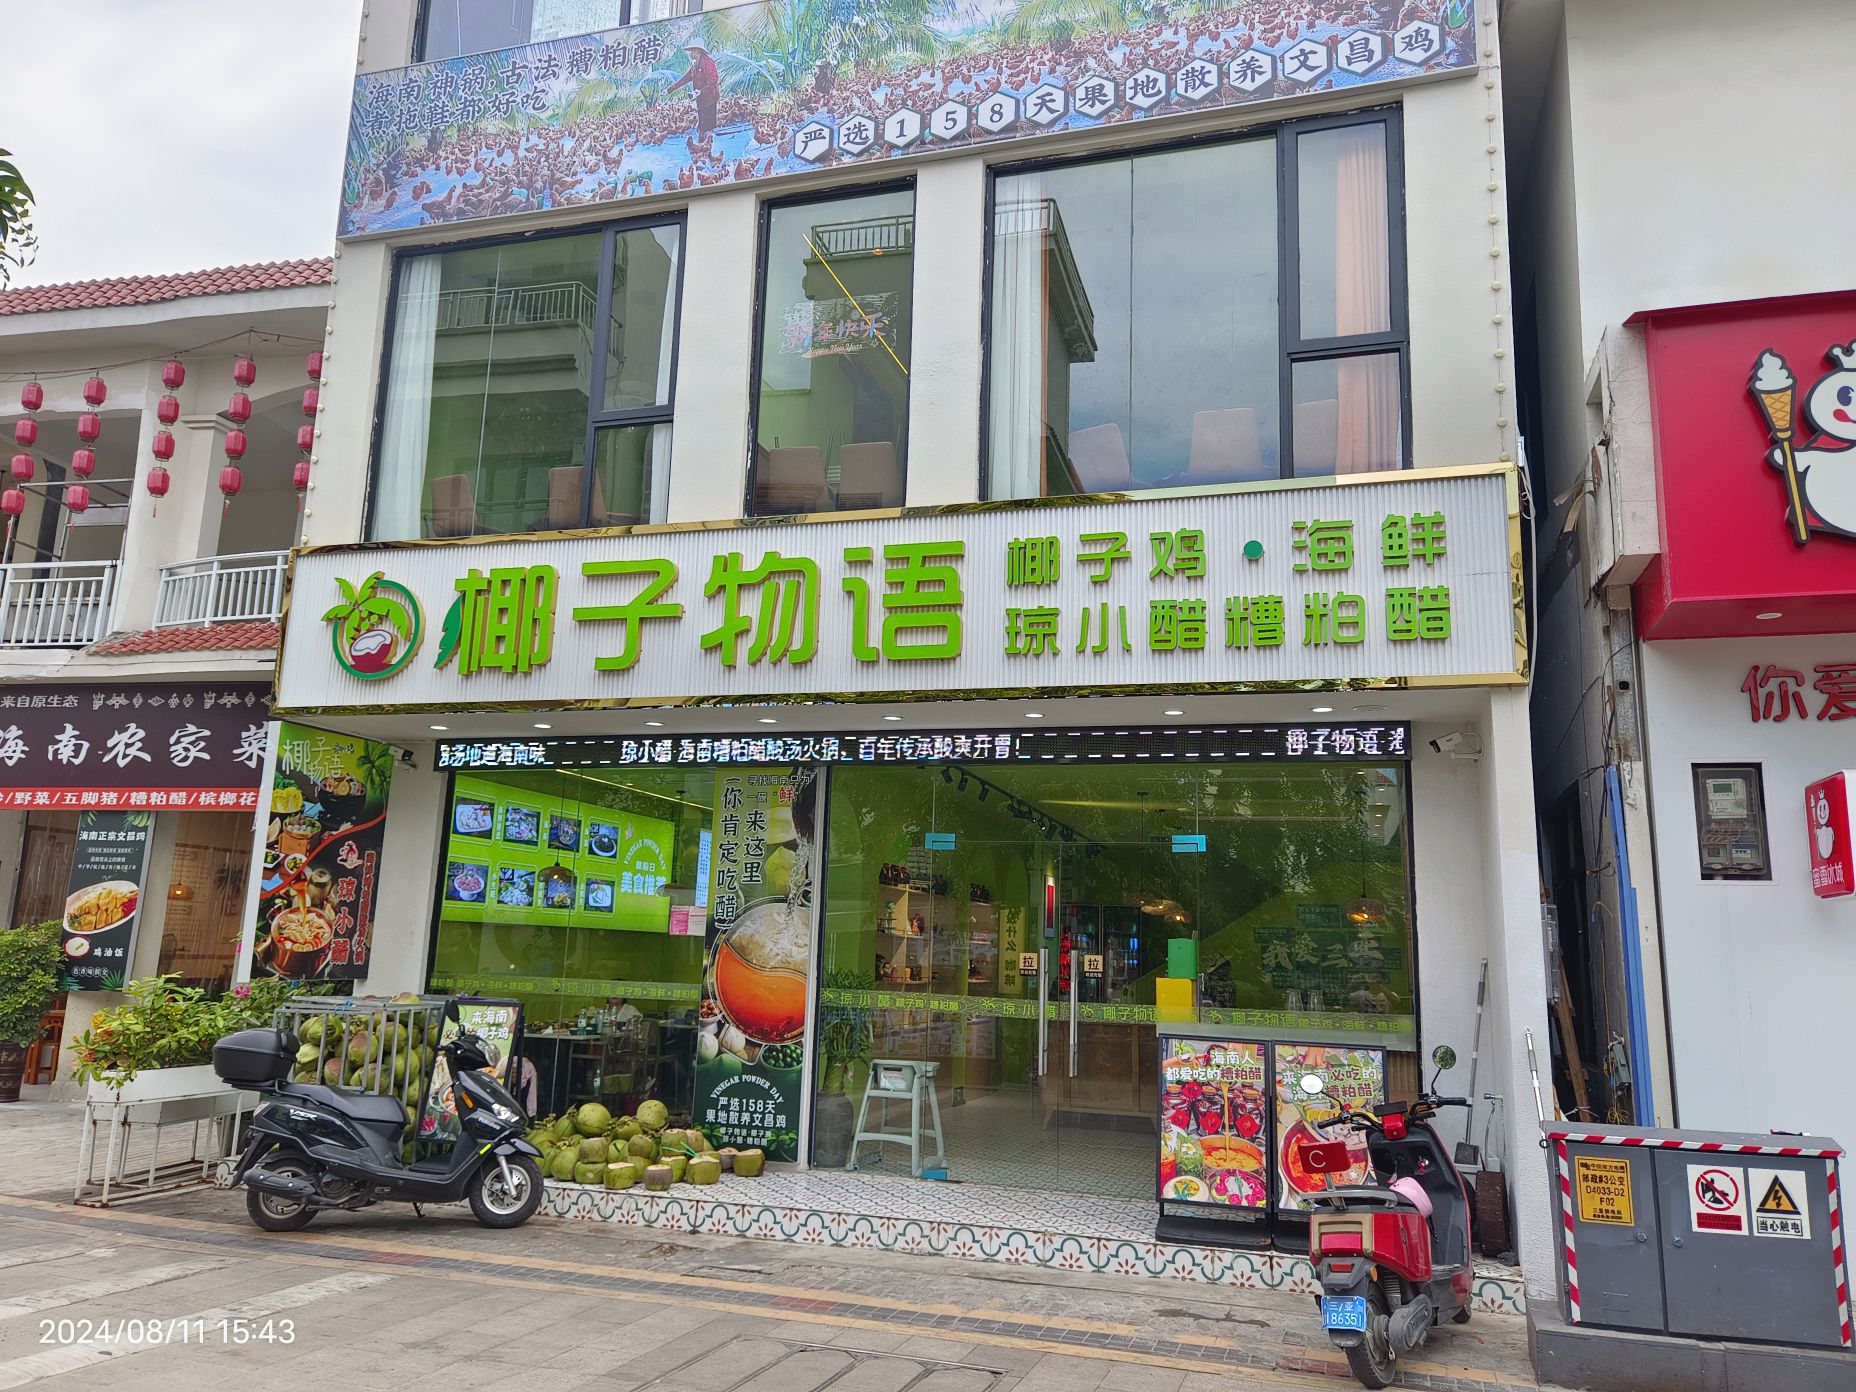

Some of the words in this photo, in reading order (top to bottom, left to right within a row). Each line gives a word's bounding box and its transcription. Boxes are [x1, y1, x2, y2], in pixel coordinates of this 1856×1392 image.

[799, 26, 1436, 154] 严选158天果地散养文昌鸡
[364, 85, 550, 138] 煮拖鞋都好吃
[1006, 510, 1448, 587] 椰子鸡·海鲜
[434, 539, 968, 677] 椰子物语
[1004, 584, 1451, 656] 琼小醋糟粕醋
[0, 694, 79, 709] 来自原生态
[1740, 664, 1856, 723] 你爱
[0, 721, 270, 769] 海南农家菜
[79, 830, 146, 841] 海南正宗文昌鸡
[741, 809, 767, 884] 来这里
[331, 876, 357, 964] 琼小醋
[1023, 955, 1035, 968] 拉
[1087, 958, 1100, 970] 拉
[471, 1010, 509, 1025] 来海南
[1211, 1049, 1256, 1065] 海南人
[1166, 1066, 1262, 1081] 都爱吃的糟粕醋
[709, 1075, 740, 1099] VINEGAR
[742, 1074, 771, 1090] POWDER
[770, 1086, 785, 1104] DAY
[717, 1096, 776, 1114] 严选158天
[705, 1108, 787, 1128] 果地散养文昌鸡
[1585, 1185, 1625, 1197] D4033-D2
[1599, 1197, 1615, 1206] F02
[1759, 1220, 1801, 1234] 当心触电
